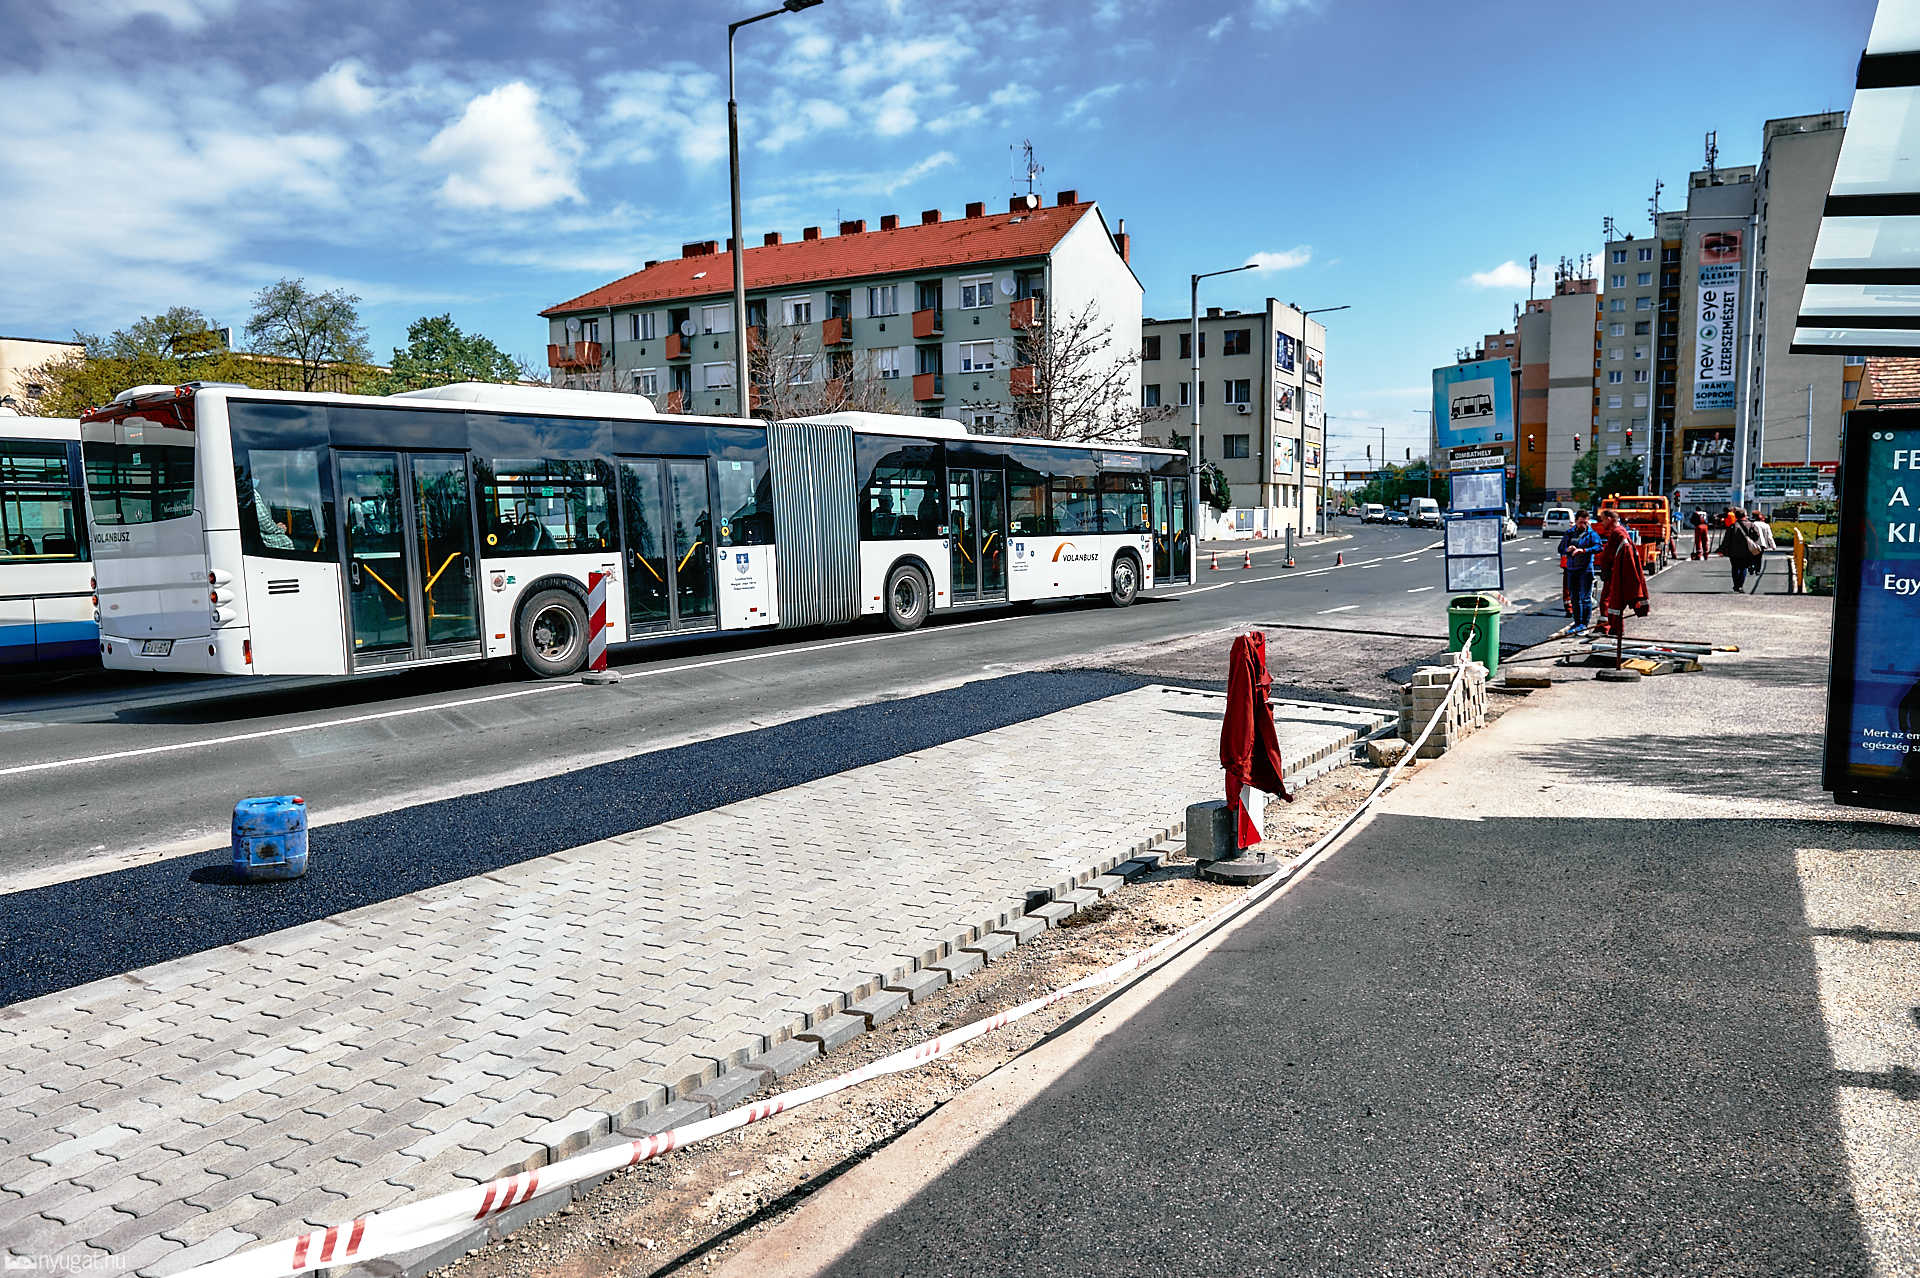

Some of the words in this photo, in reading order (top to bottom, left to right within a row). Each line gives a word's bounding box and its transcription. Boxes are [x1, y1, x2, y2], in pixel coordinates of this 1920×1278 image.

[1702, 290, 1719, 322] eye
[1718, 291, 1735, 376] LÉZERSZEMÉSZET
[1700, 343, 1714, 379] new
[1888, 486, 1910, 507] A
[1863, 728, 1890, 738] Mert
[1891, 731, 1904, 739] az
[1862, 741, 1910, 754] egészség
